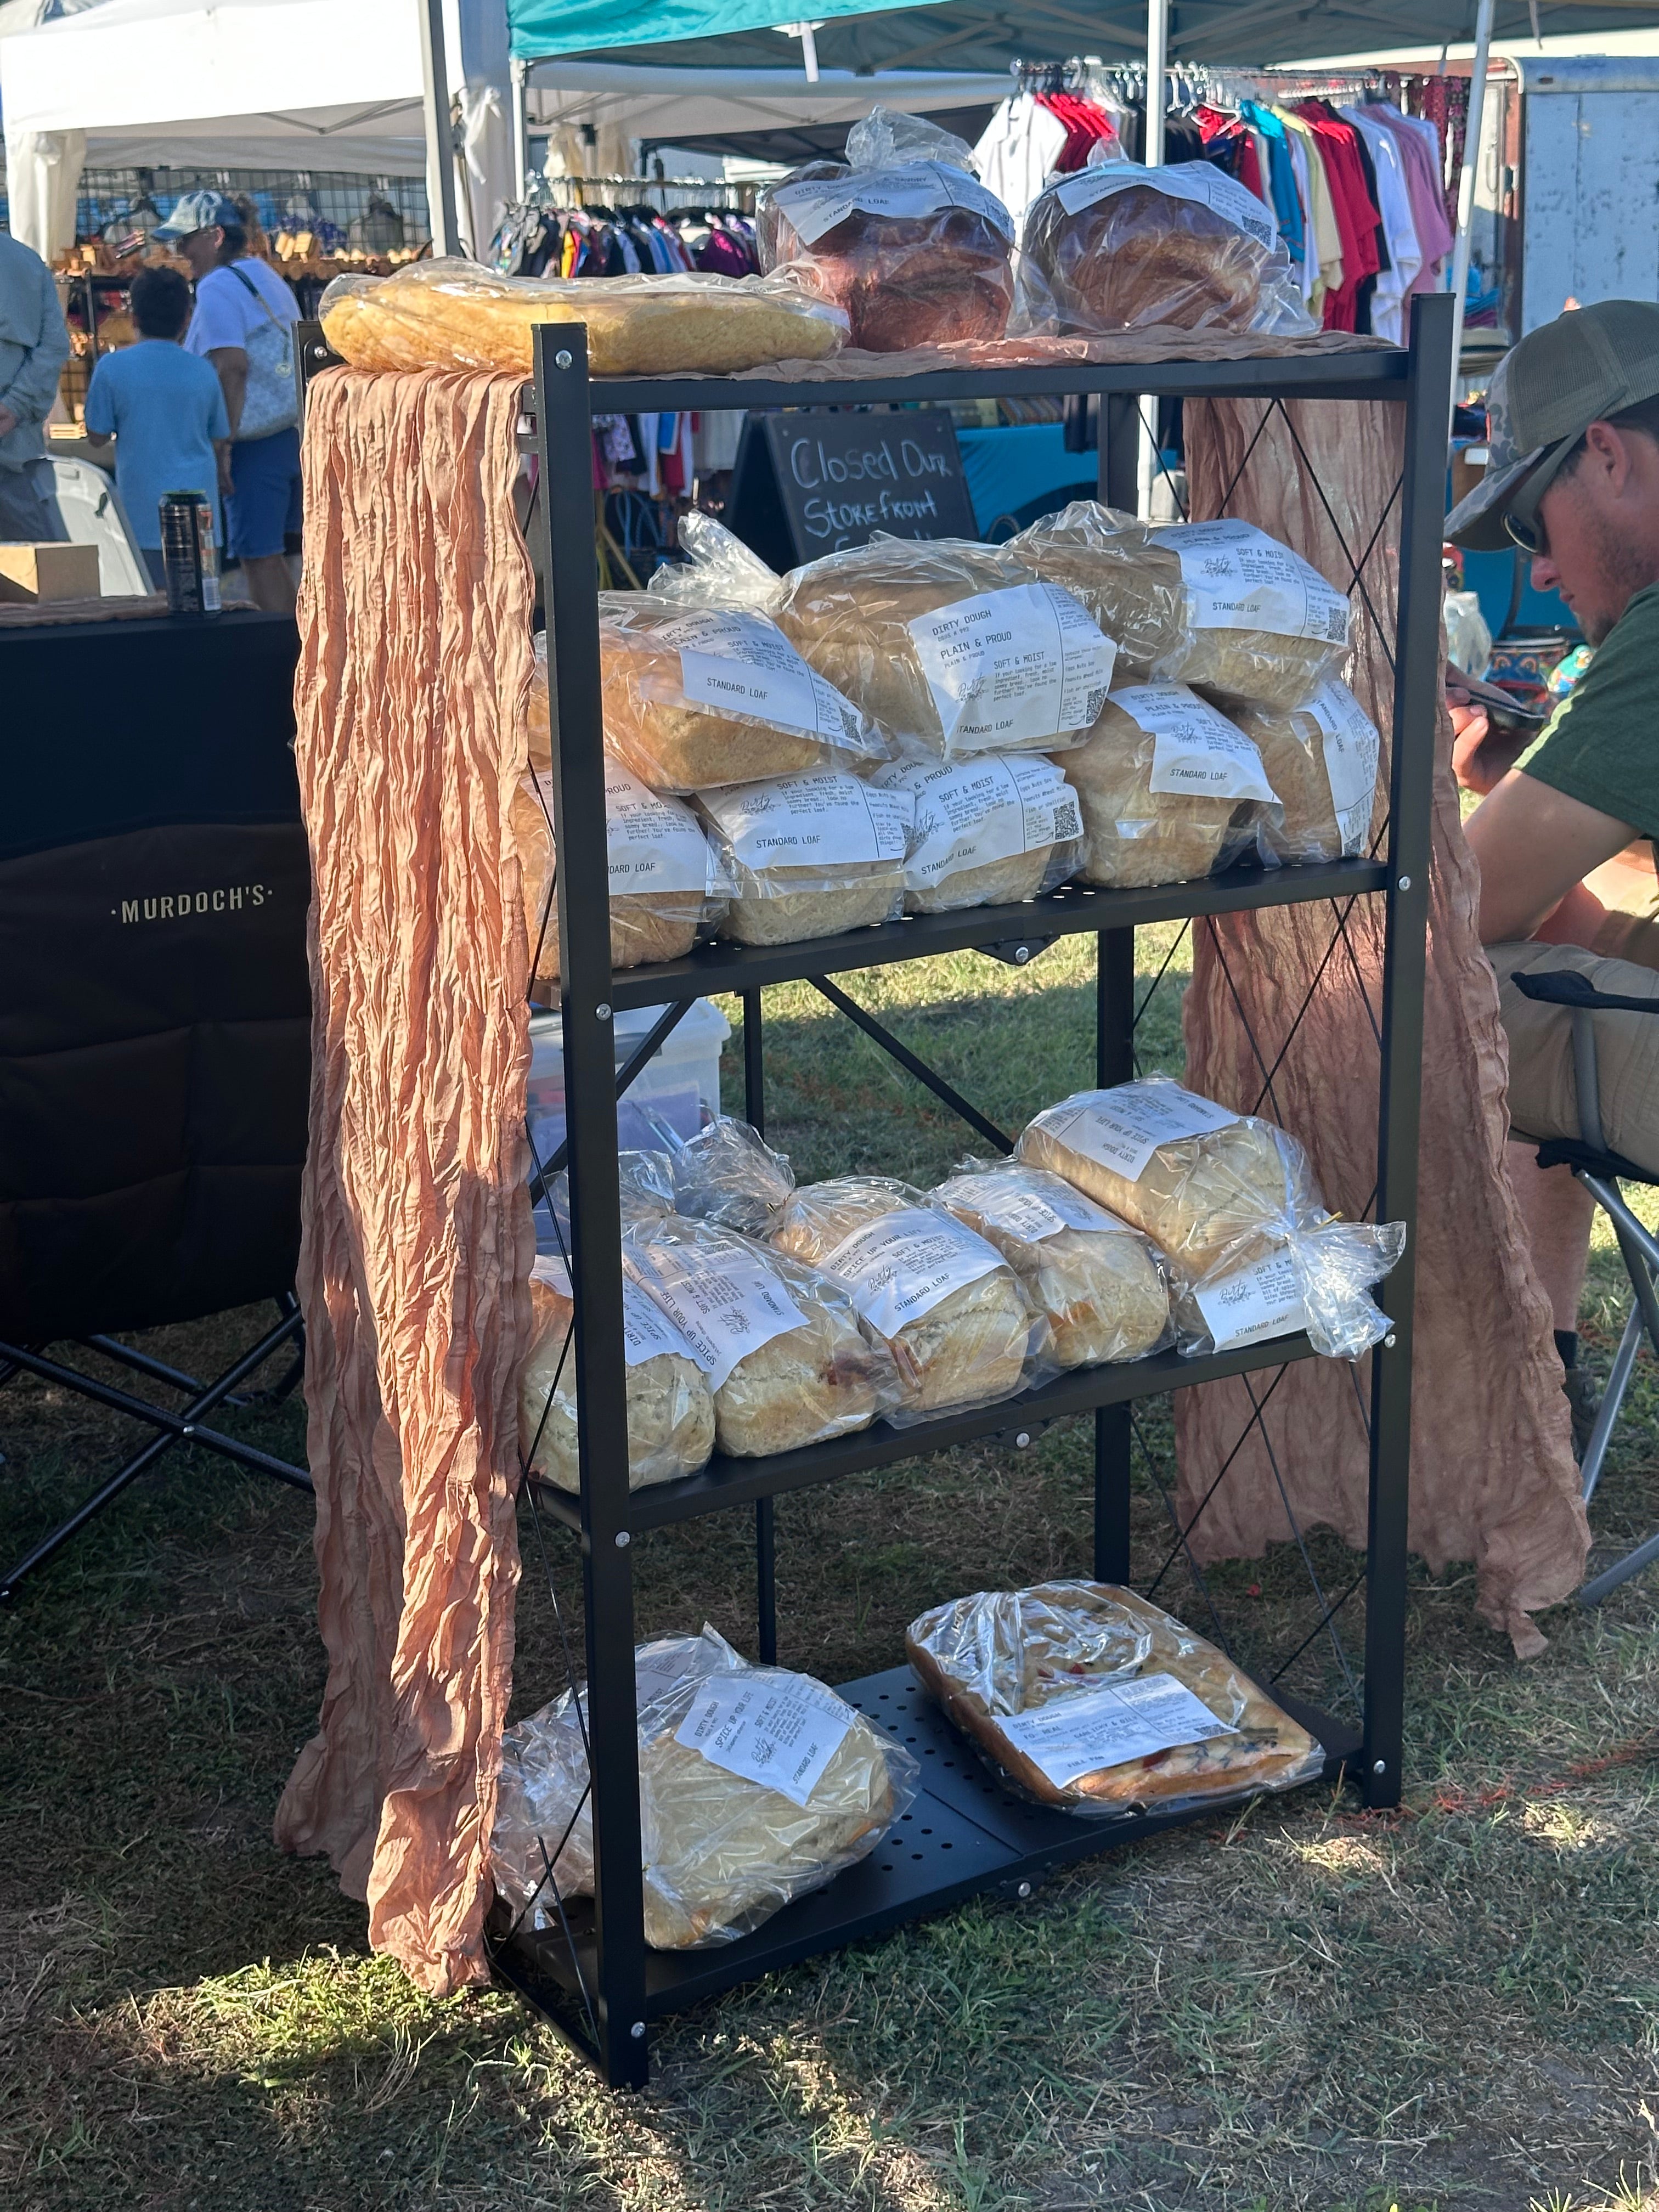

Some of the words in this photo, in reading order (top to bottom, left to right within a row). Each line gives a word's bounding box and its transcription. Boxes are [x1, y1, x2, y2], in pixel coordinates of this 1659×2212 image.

[790, 437, 899, 489] Closed
[1235, 548, 1253, 556] SOFT
[1212, 601, 1245, 612] STANDARD
[1246, 603, 1261, 613] LOAF
[661, 627, 682, 641] IRTY
[686, 617, 714, 628] DOUGH
[712, 627, 742, 635] PROUD
[932, 619, 959, 636] DIRTY
[964, 610, 992, 624] DOUGH
[727, 640, 749, 648] SOFT
[761, 641, 785, 652] MOIST
[940, 641, 970, 660] PLAIN
[974, 638, 982, 647] &
[985, 631, 1012, 645] PROUD
[944, 658, 960, 669] PLAIN
[969, 651, 985, 659] PROUD
[994, 658, 1011, 670] SOFT
[1015, 657, 1020, 665] &
[1023, 651, 1045, 663] MOIST
[707, 678, 746, 695] STANDARD
[749, 687, 769, 700] LOAF
[996, 719, 1014, 731] LOAF
[1335, 733, 1345, 754] LOAF
[777, 781, 798, 790] SOFT
[812, 776, 838, 785] MOIST
[924, 765, 953, 784] PROUD
[1170, 768, 1207, 780] STANDARD
[1210, 772, 1228, 781] LOAF
[606, 783, 631, 795] ROUD
[939, 788, 959, 803] SOFT
[962, 786, 968, 794] &
[971, 776, 994, 791] MOIST
[965, 792, 985, 802] looking
[616, 803, 637, 812] SOFT
[756, 836, 798, 849] STANDARD
[802, 834, 821, 845] LOAF
[607, 863, 630, 874] DARD
[635, 862, 656, 873] LOAF
[921, 853, 955, 875] STANDARD
[957, 846, 977, 857] LOAF
[121, 884, 264, 924] MURDOCH'S
[1187, 1101, 1214, 1120] STANDARD
[1095, 1115, 1110, 1127] LIFE
[1109, 1123, 1122, 1133] YOUR
[1122, 1128, 1131, 1138] UP
[1131, 1132, 1149, 1144] SPICE
[1117, 1151, 1136, 1164] DIRTY
[1020, 1220, 1039, 1234] DIRTY
[830, 1250, 851, 1271] DIRTY
[852, 1231, 876, 1249] DOUGH
[892, 1246, 911, 1259] SOFT
[921, 1234, 945, 1245] MOIST
[843, 1256, 866, 1278] SPICE
[866, 1246, 878, 1256] UP
[880, 1234, 902, 1248] YOUR
[680, 1280, 695, 1294] MOIST
[894, 1286, 931, 1313] STANDARD
[932, 1272, 951, 1287] LOAF
[659, 1289, 676, 1307] LIFE
[761, 1291, 785, 1316] STANDARD
[696, 1301, 710, 1314] SOFT
[673, 1307, 689, 1328] YOUR
[1235, 1321, 1269, 1338] STANDARD
[1272, 1313, 1289, 1327] LOAF
[686, 1329, 697, 1341] UP
[695, 1340, 718, 1366] SPICE
[694, 1718, 709, 1737] DIRTY
[715, 1724, 732, 1748] SPICE
[728, 1714, 738, 1725] UP
[792, 1755, 811, 1785] STANDARD
[809, 1741, 820, 1758] LOAF
